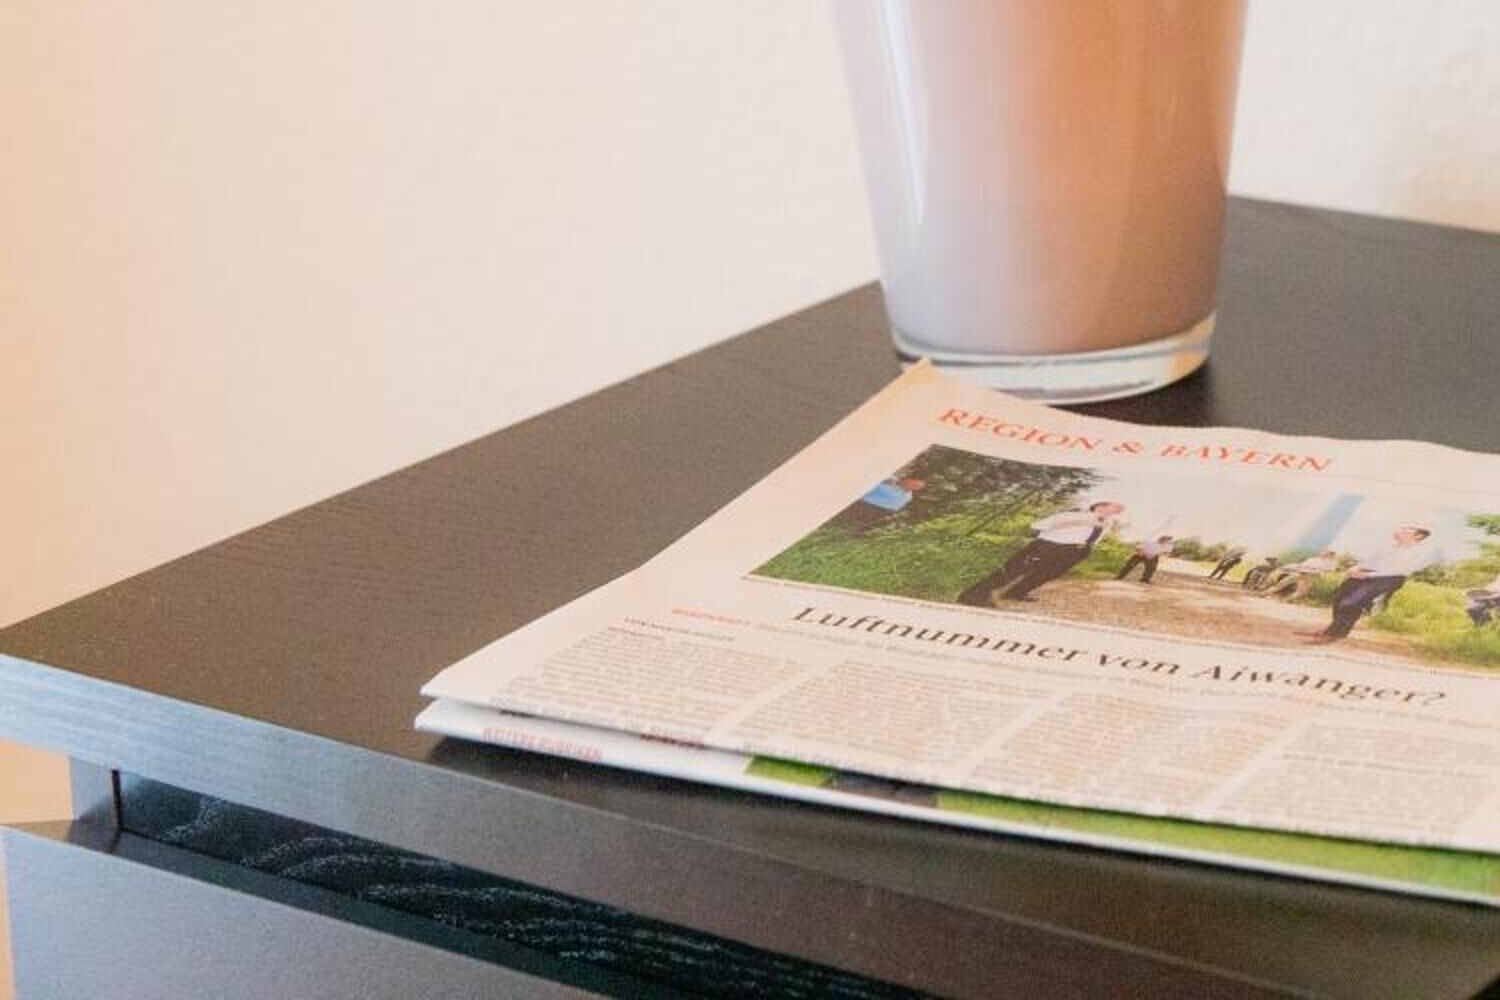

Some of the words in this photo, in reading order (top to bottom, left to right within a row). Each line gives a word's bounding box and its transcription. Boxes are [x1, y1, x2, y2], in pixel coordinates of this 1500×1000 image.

[938, 407, 1099, 452] REGION
[1112, 440, 1141, 455] &
[1160, 444, 1336, 472] BAYERN
[792, 606, 1089, 662] Luftnummer
[1098, 651, 1182, 676] von
[1189, 664, 1449, 706] Aiwanger?
